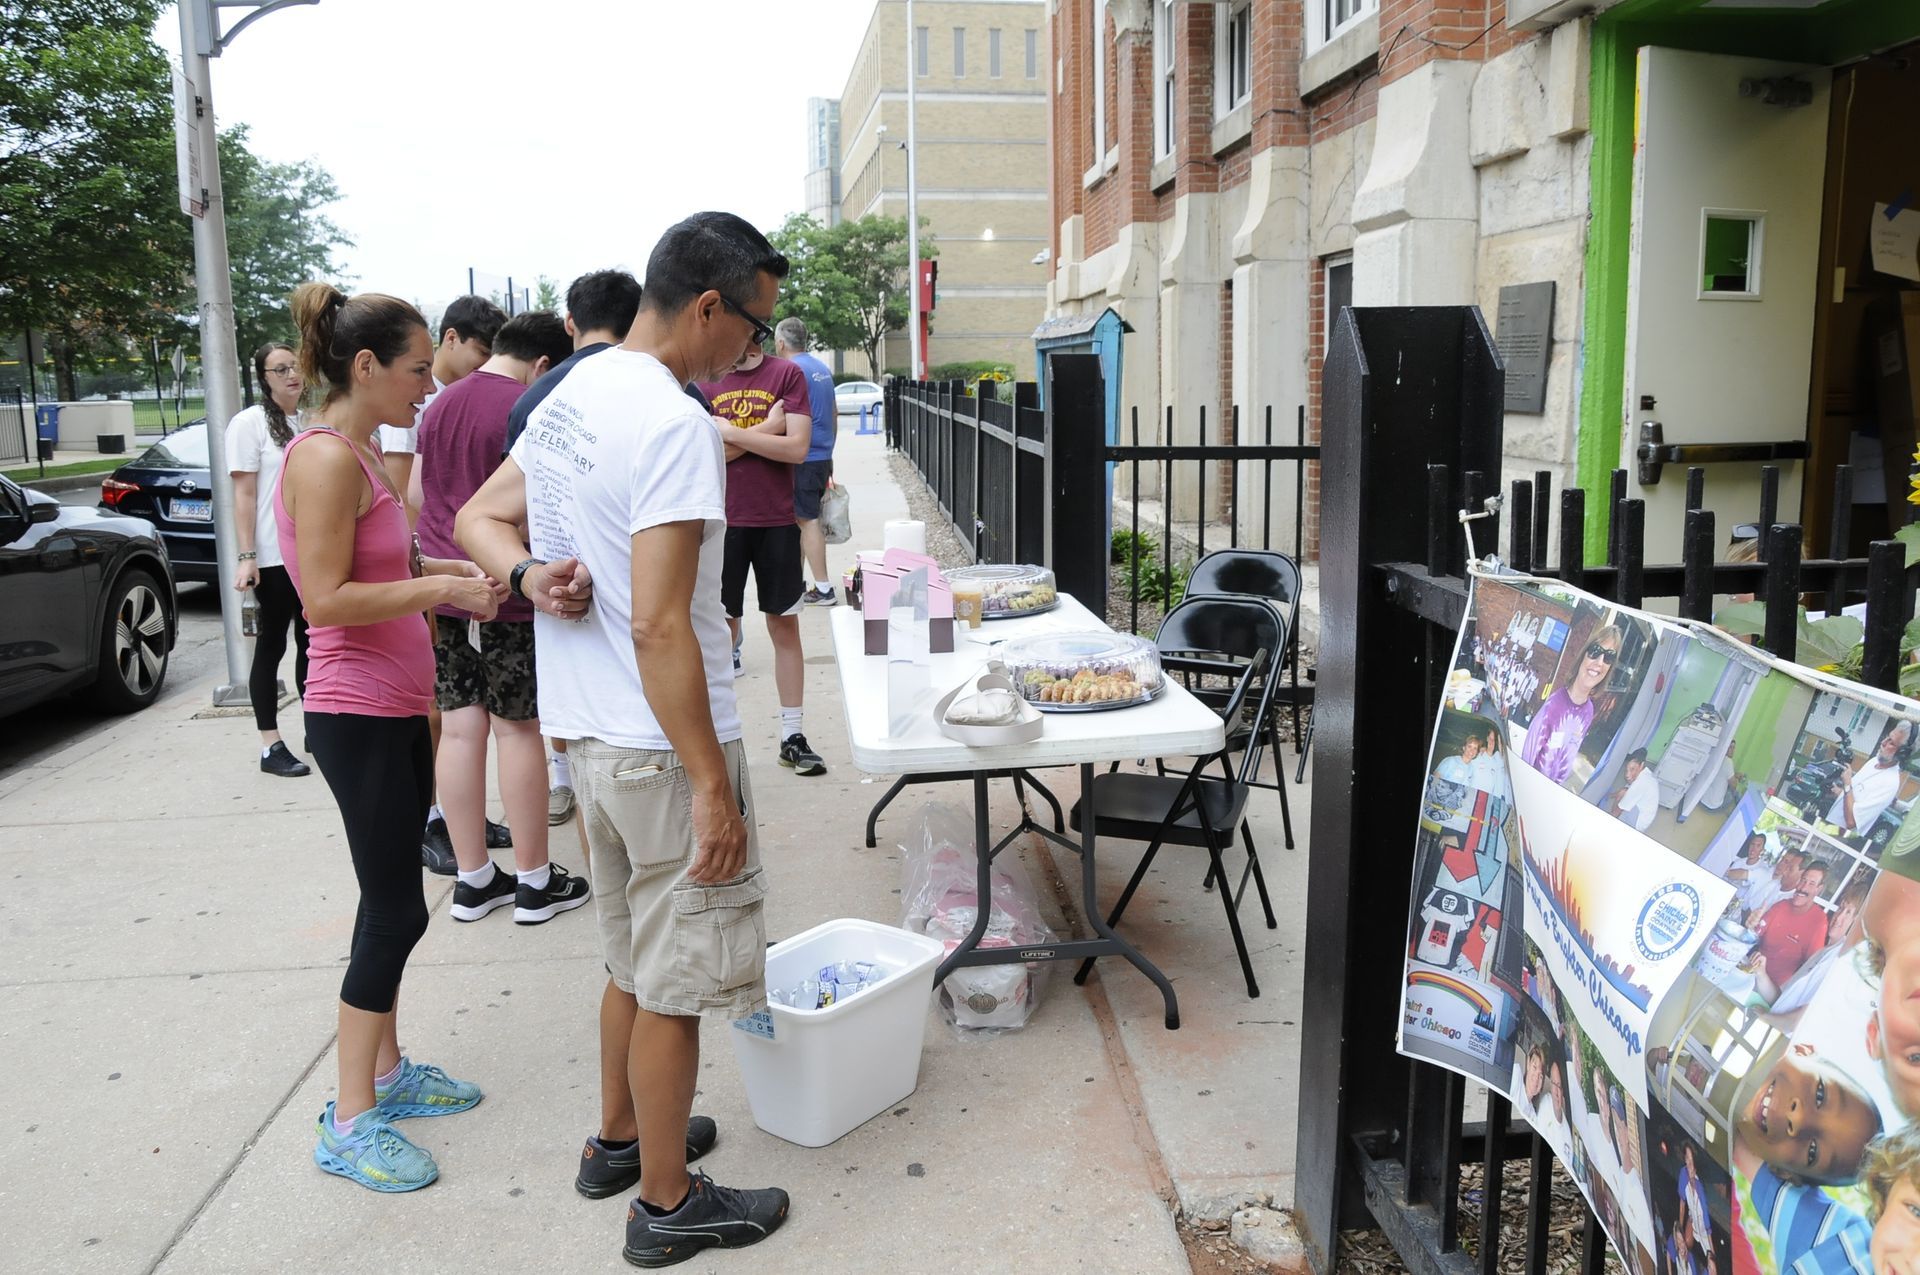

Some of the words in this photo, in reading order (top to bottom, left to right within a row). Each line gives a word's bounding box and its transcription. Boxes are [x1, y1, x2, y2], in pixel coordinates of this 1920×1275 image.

[1654, 909, 1677, 927] PAINT
[1658, 900, 1689, 924] CHICAGO
[1426, 1007, 1433, 1016] a
[1421, 1016, 1462, 1040] Chicago
